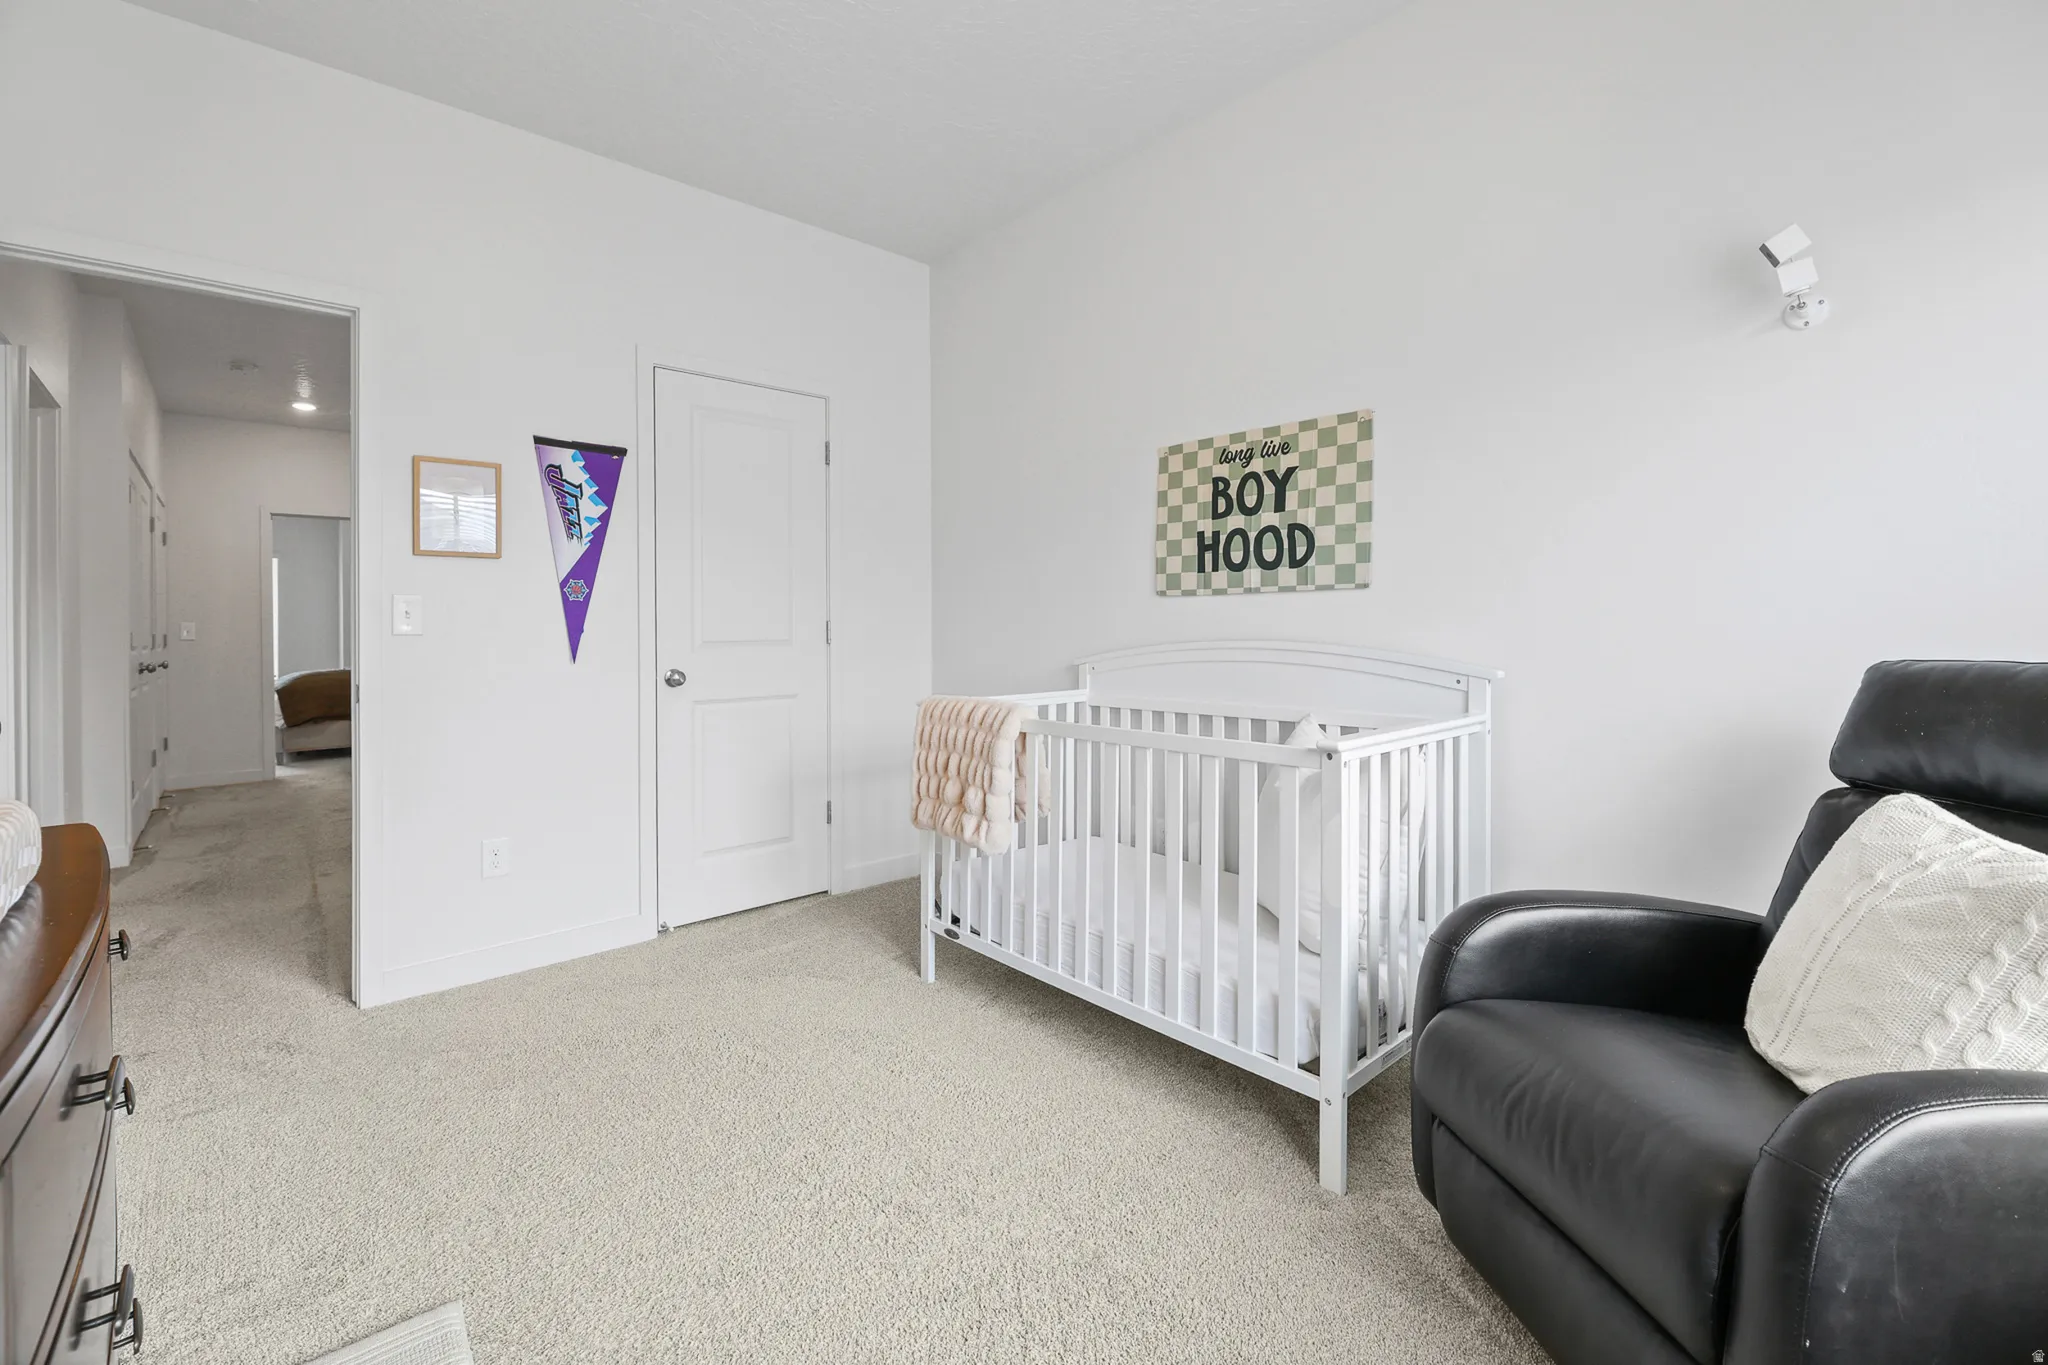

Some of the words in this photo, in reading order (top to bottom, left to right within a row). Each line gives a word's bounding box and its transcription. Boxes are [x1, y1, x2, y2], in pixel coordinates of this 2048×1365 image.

[1219, 448, 1255, 468] long
[1260, 440, 1292, 457] live
[1211, 466, 1299, 520] BOY
[1197, 523, 1315, 574] HOOD
